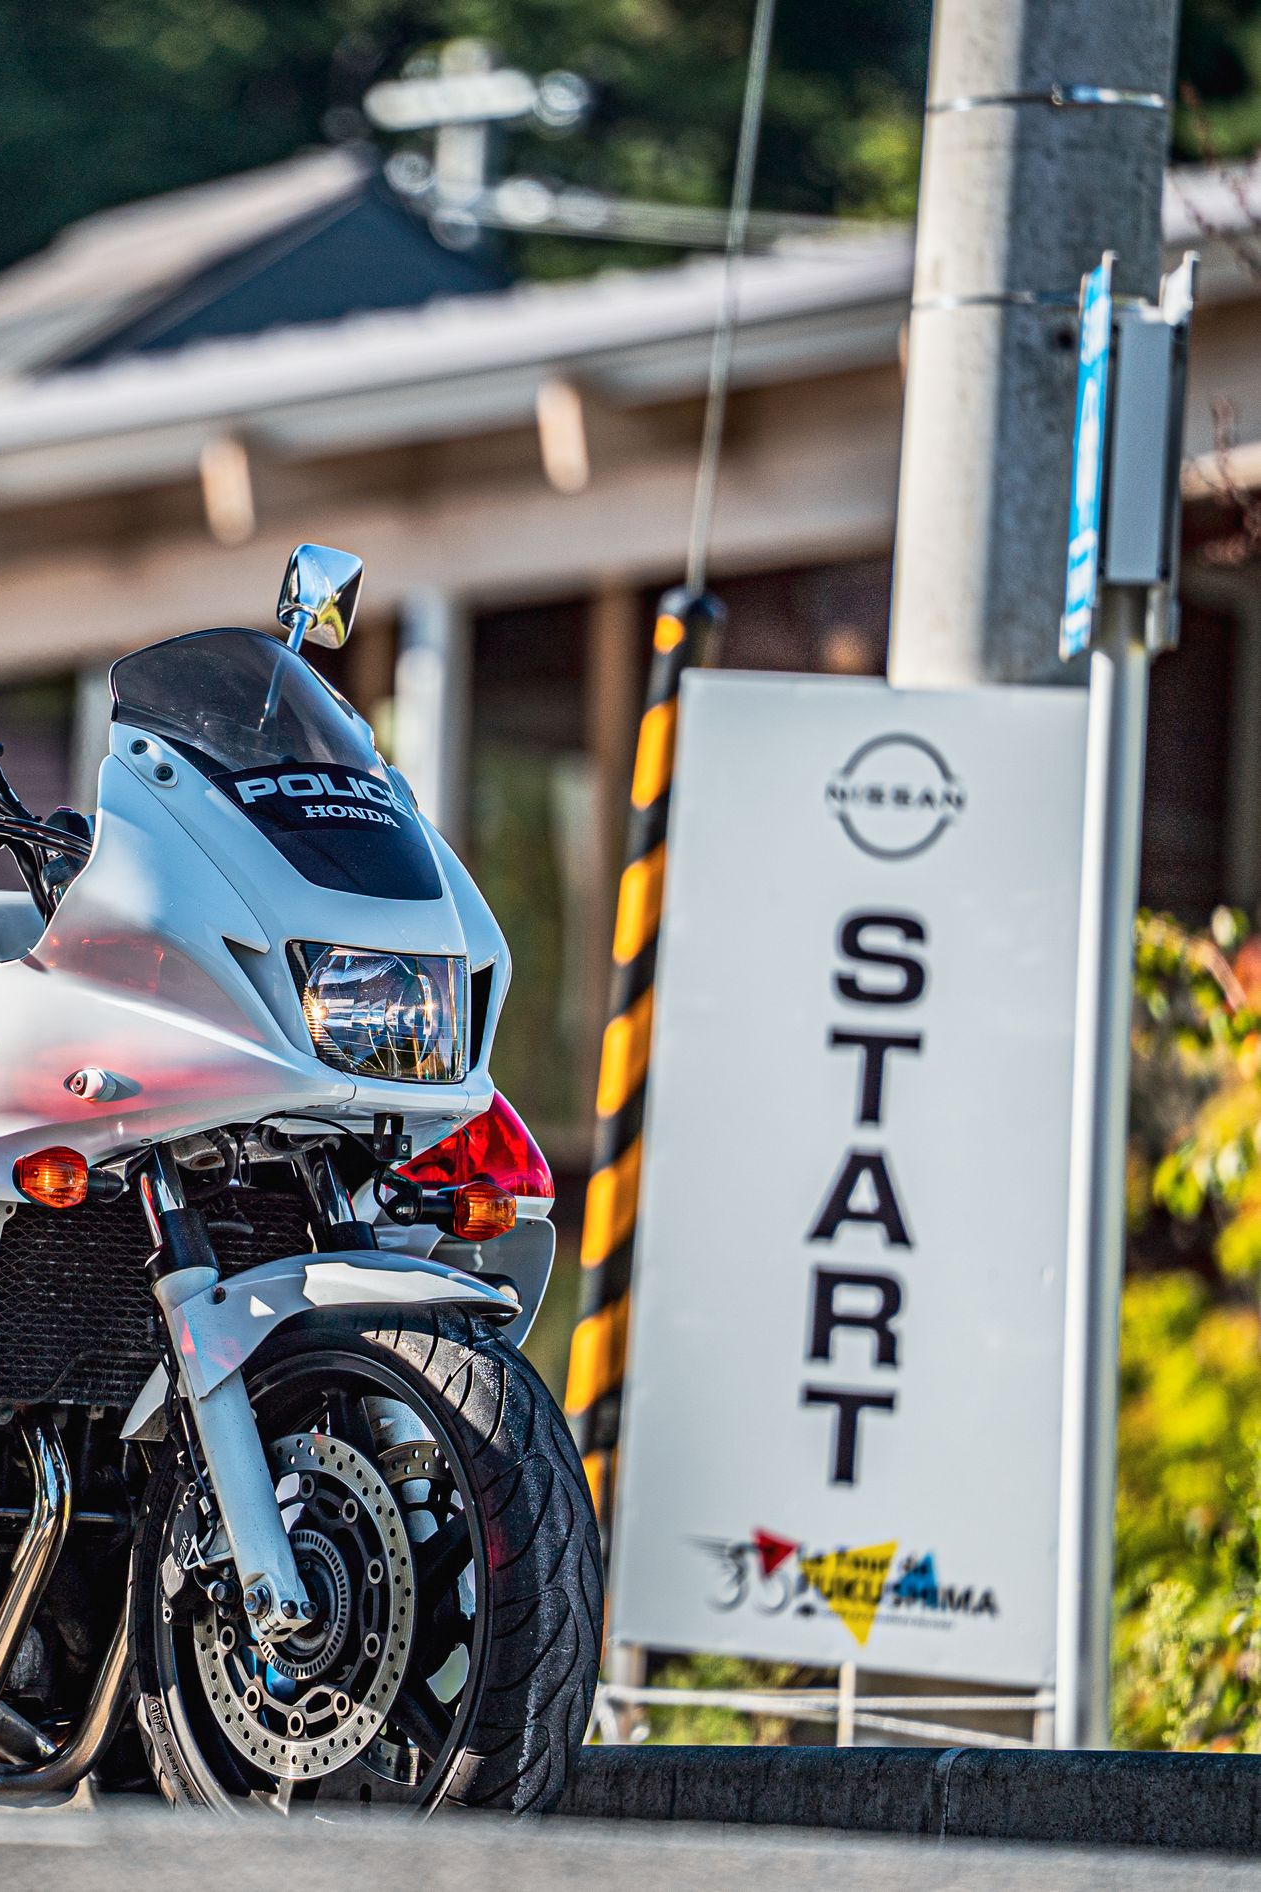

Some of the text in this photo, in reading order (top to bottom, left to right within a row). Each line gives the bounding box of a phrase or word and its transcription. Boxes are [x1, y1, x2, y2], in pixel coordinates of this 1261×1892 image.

[234, 773, 414, 821] POLICE
[825, 784, 967, 812] NISSAN
[302, 805, 401, 829] HONDA
[801, 910, 928, 1487] START
